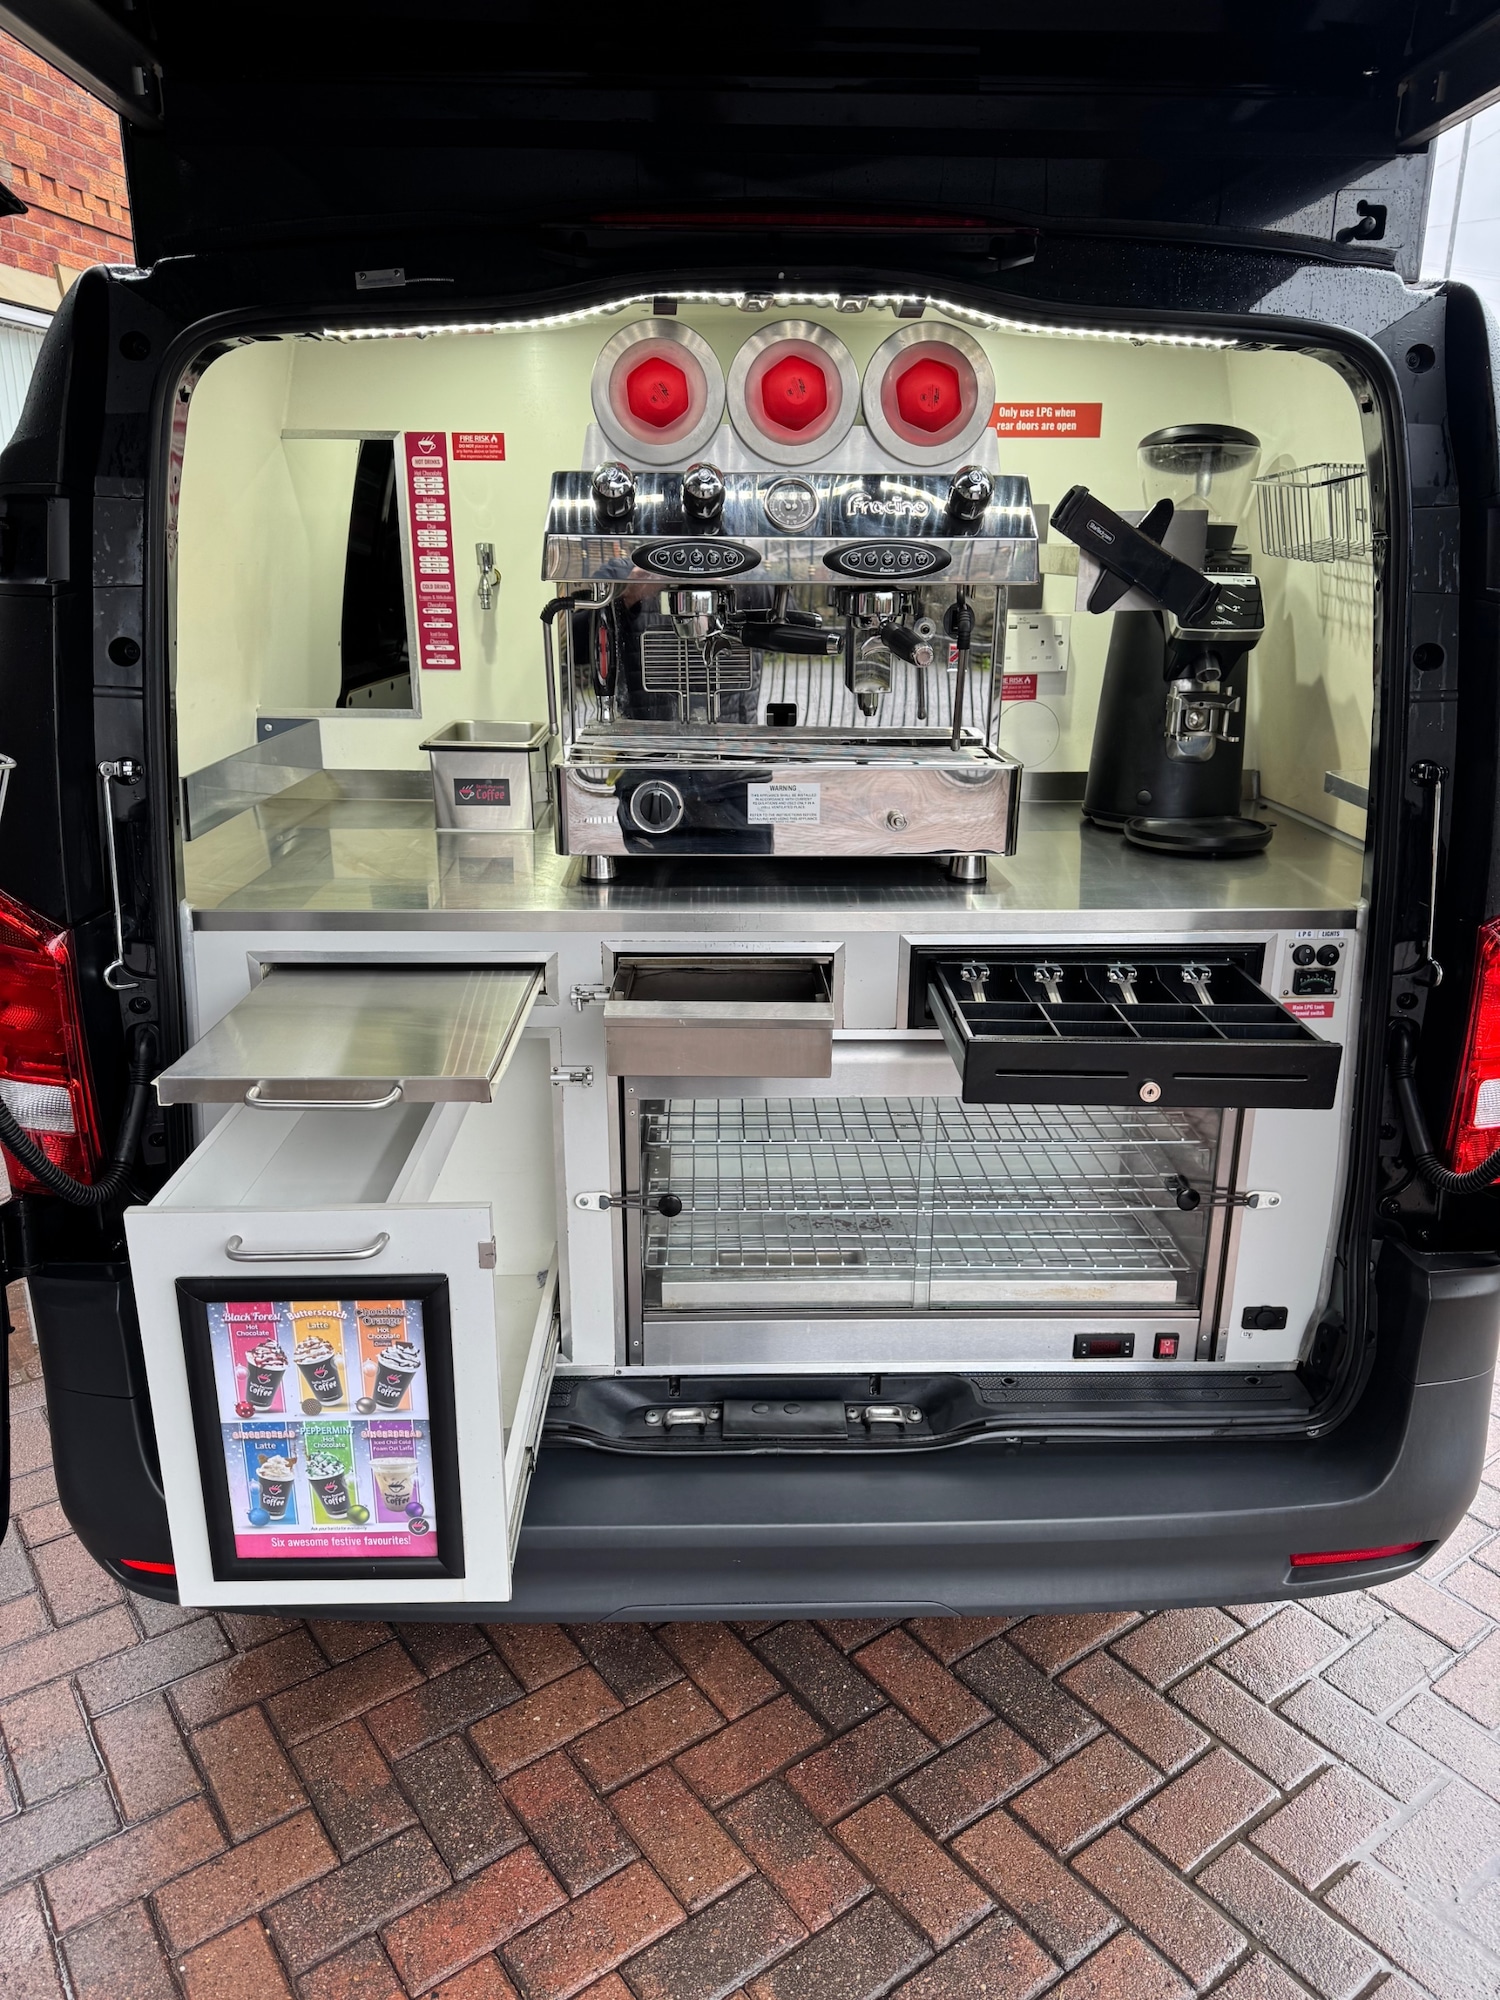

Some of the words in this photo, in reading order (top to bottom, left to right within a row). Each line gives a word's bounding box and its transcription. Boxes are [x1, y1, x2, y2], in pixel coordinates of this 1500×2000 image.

[999, 407, 1017, 418] Only
[1020, 409, 1034, 418] use
[1036, 407, 1052, 418] LPG
[1055, 407, 1076, 418] when
[1016, 420, 1039, 430] doors
[1041, 422, 1054, 430] are
[1057, 422, 1076, 432] open
[476, 789, 505, 801] Coffee
[223, 1312, 251, 1321] Black
[252, 1312, 281, 1321] Forest
[286, 1310, 348, 1320] Butterscotch
[363, 1317, 402, 1327] Orange
[249, 1385, 273, 1397] Coffee
[314, 1380, 337, 1392] Coffee
[377, 1385, 400, 1397] Coffee
[232, 1430, 296, 1439] GINGERBREAD
[300, 1426, 354, 1435] PEPPERMINT
[361, 1430, 422, 1438] GINGERBREAD
[262, 1496, 285, 1506] Coffee
[324, 1495, 346, 1505] Coffee
[386, 1496, 410, 1505] Coffee
[271, 1538, 285, 1548] Six
[288, 1538, 329, 1547] awesome
[331, 1536, 361, 1546] festive
[364, 1535, 411, 1545] favourites!
